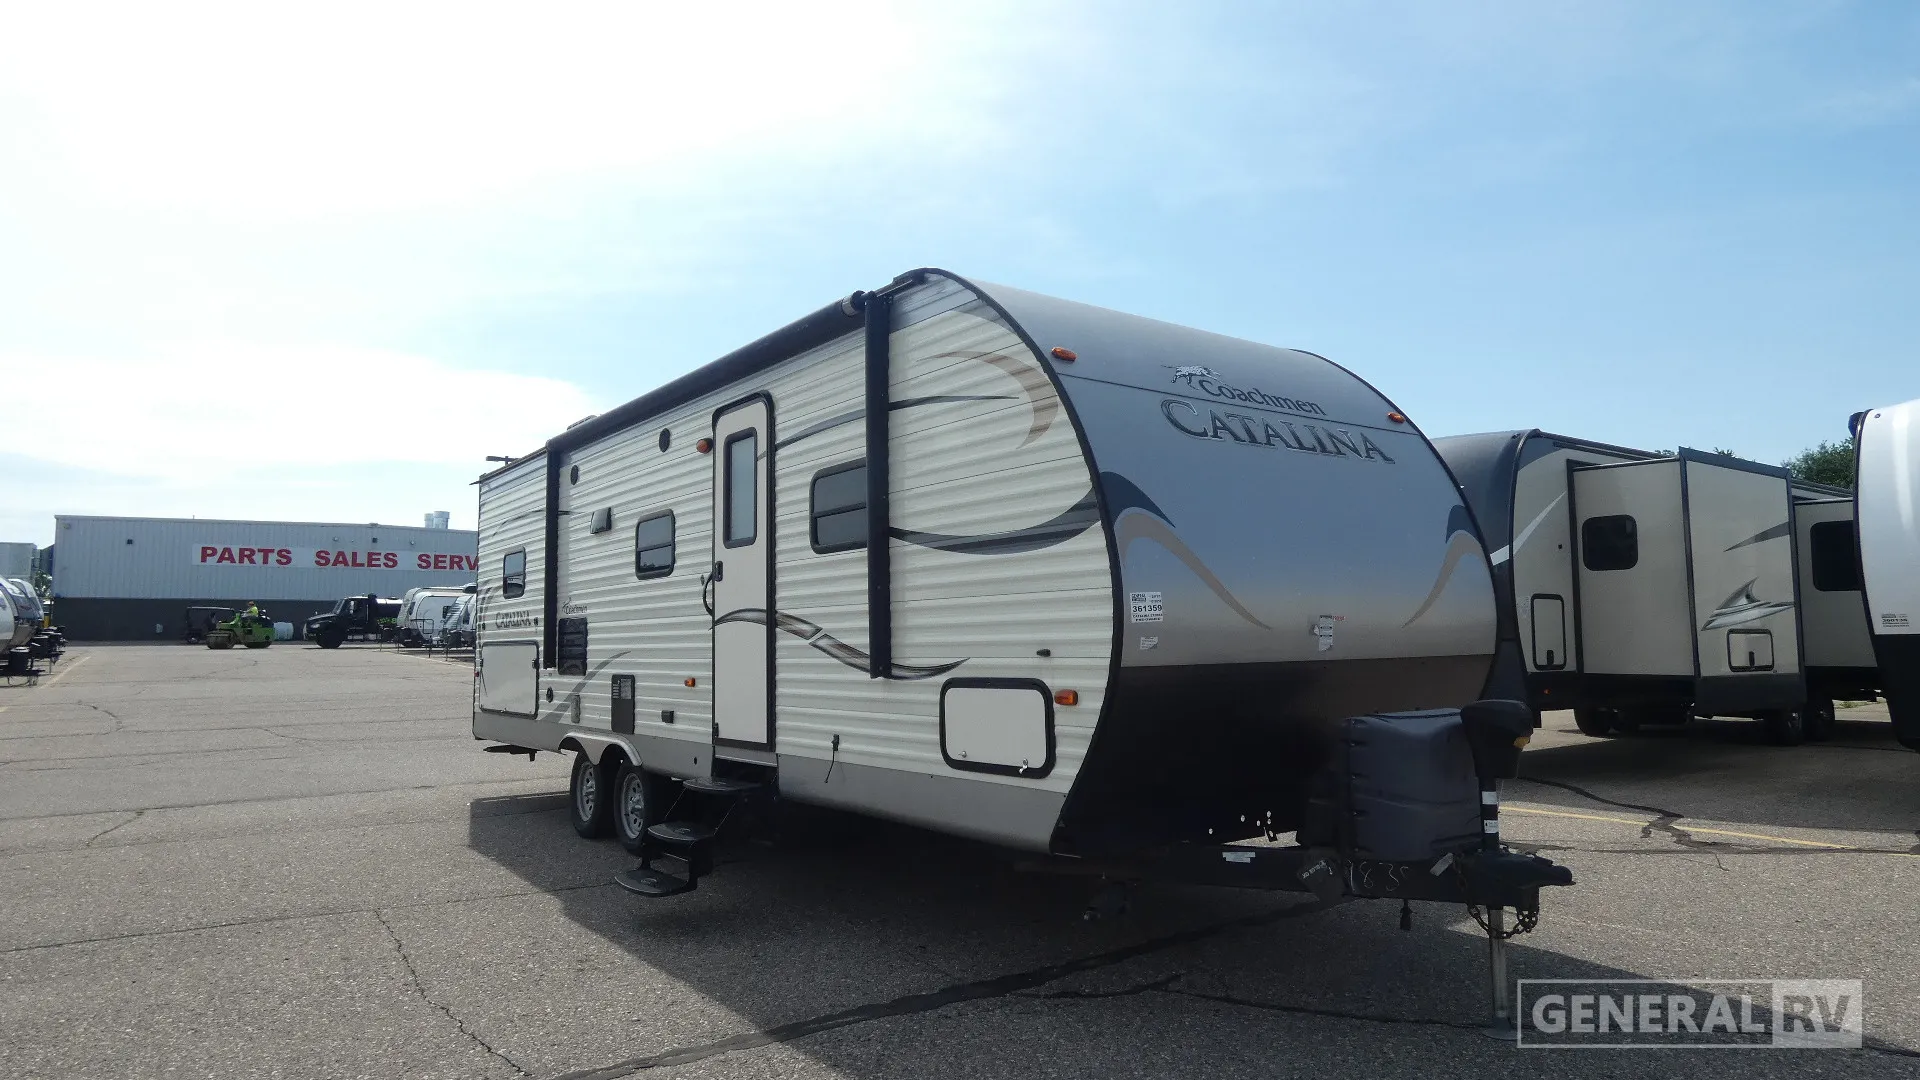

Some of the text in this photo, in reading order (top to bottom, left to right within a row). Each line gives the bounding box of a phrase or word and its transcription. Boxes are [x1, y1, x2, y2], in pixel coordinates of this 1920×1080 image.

[1199, 380, 1326, 415] Coachmen
[1161, 399, 1396, 464] CATALINA
[201, 546, 478, 570] PARTS SALES SERV
[495, 610, 531, 628] CATALINA
[1132, 604, 1163, 613] 361359
